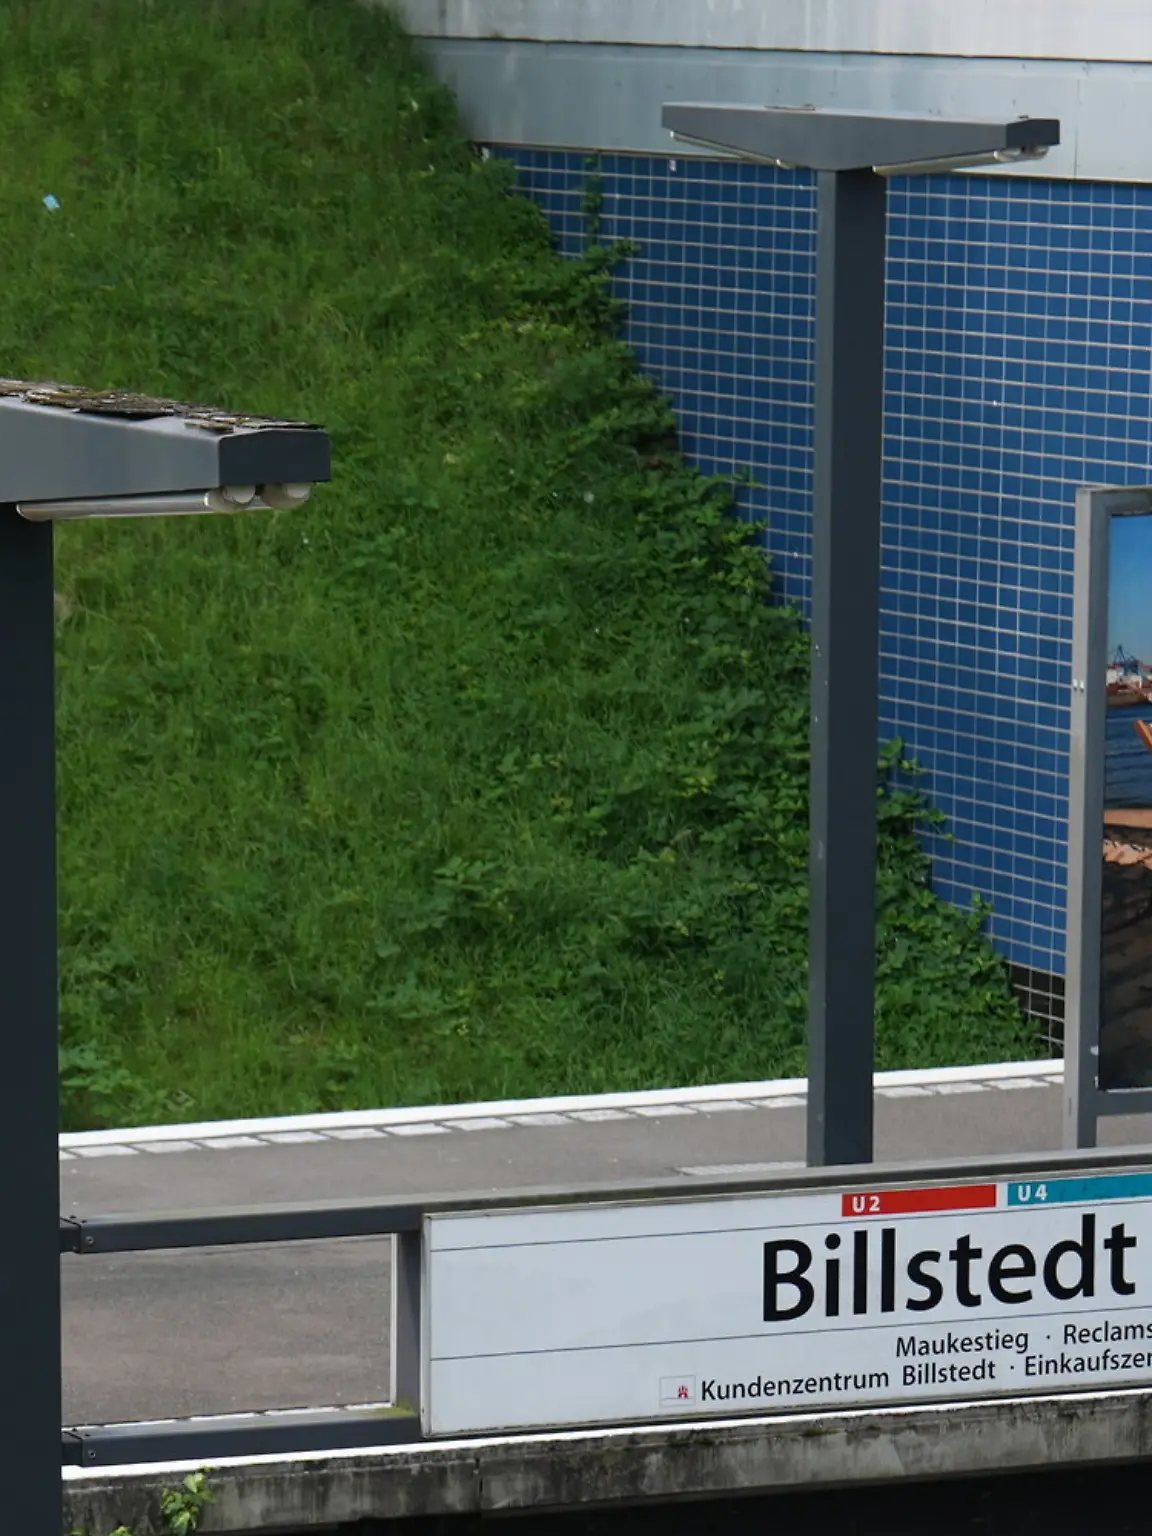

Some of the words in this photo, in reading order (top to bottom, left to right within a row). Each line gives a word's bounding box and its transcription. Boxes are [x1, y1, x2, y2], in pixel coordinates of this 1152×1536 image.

[852, 1195, 880, 1214] U2
[1017, 1184, 1047, 1202] U4
[762, 1213, 1137, 1323] Billstedt
[895, 1325, 1030, 1358] Maukestieg
[700, 1368, 890, 1402] Kundenzentrum
[902, 1359, 997, 1387] Billstedt
